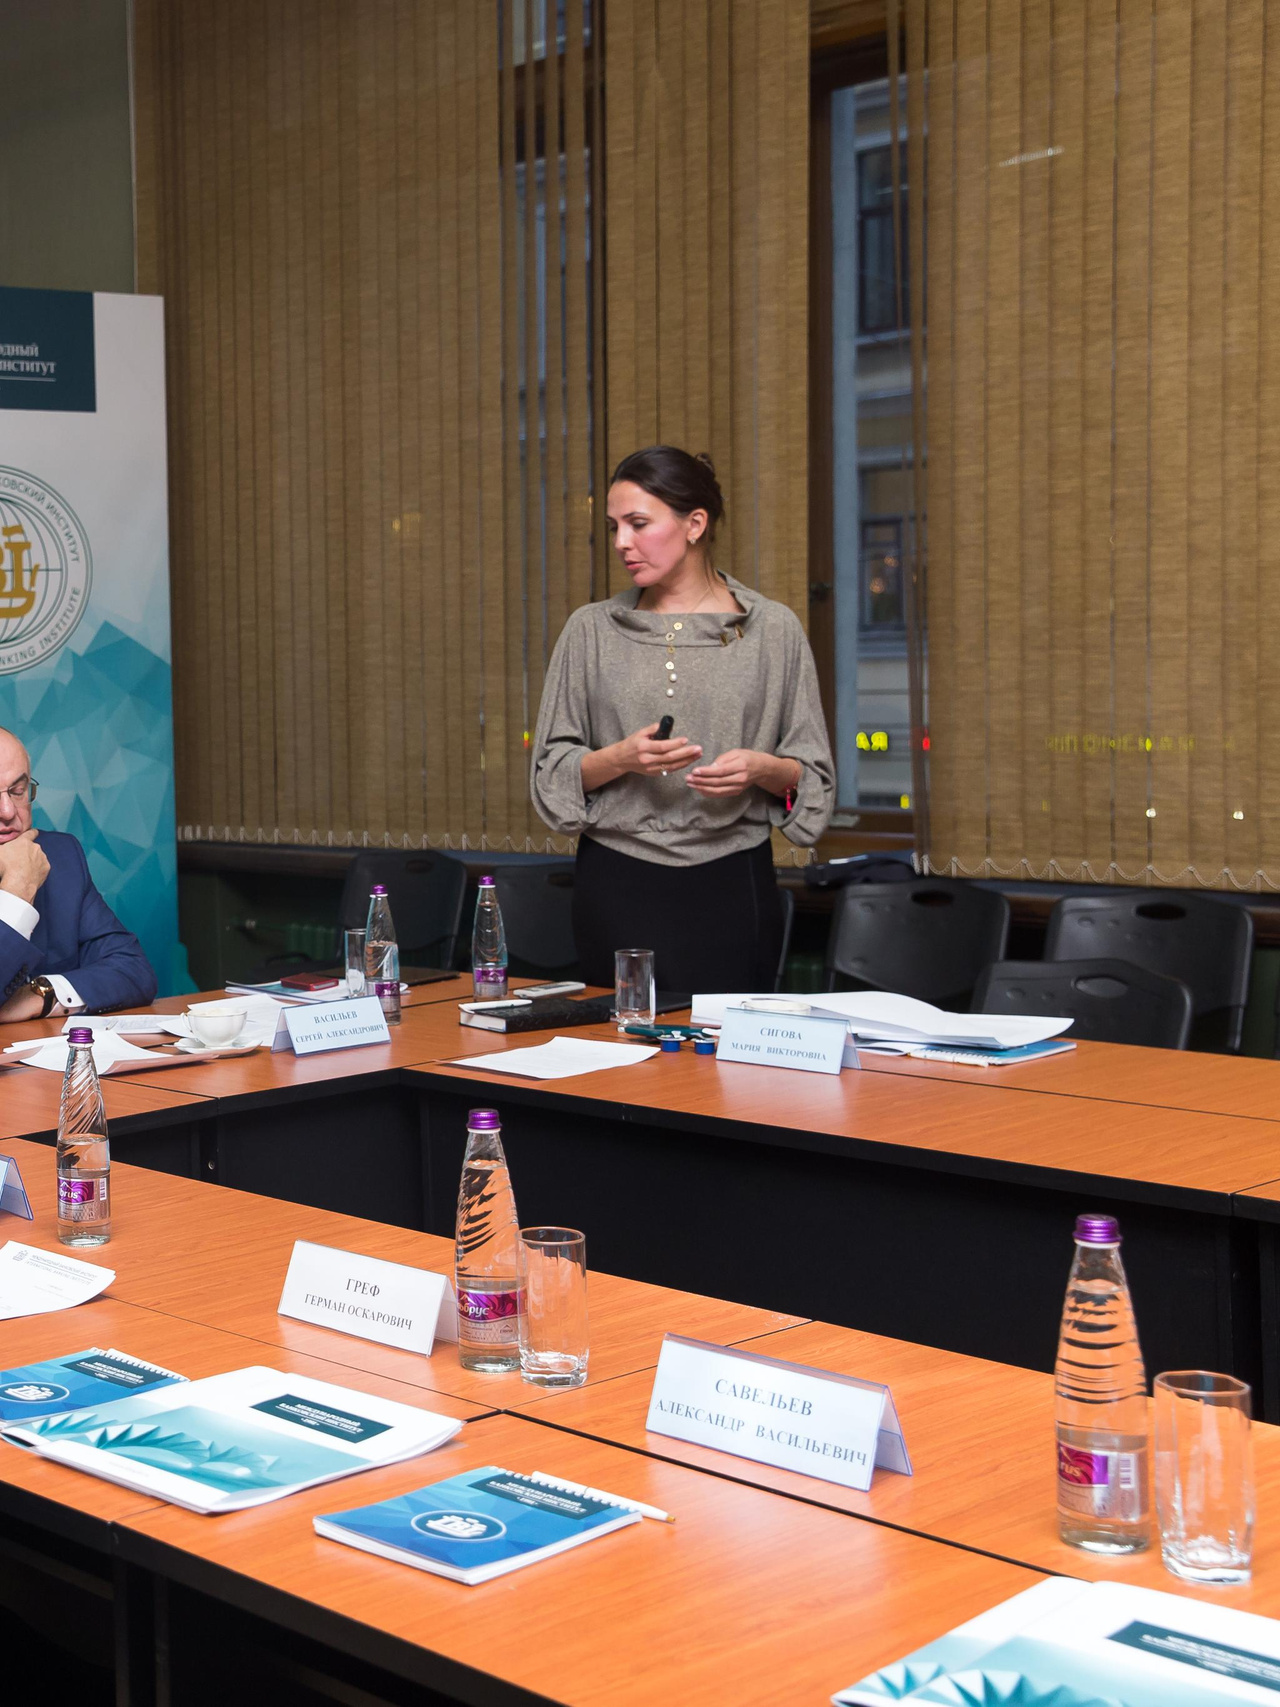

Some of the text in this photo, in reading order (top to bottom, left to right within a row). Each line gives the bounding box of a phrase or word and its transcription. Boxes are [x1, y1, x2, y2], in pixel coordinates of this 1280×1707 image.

[45, 501, 80, 563] ИНСТИТУТ
[39, 587, 81, 649] INSTITUTE
[313, 1011, 358, 1024] ВАСИЛЬЕВ
[295, 1023, 385, 1043] СЕРГЕЙ АЛЕКСАНДРОВИЧ
[760, 1027, 802, 1040] СИГОВА
[730, 1042, 826, 1061] МАРИЯ ВИКТОРОВНА
[345, 1278, 380, 1297] ГРЕФ
[304, 1293, 413, 1330] ГЕРМАН ОСКАРОВИЧ
[715, 1378, 814, 1417] САВЕЛЬЕВ
[655, 1399, 868, 1467] АЛЕКСАНДР ВАСИЛЬЕВИЧ
